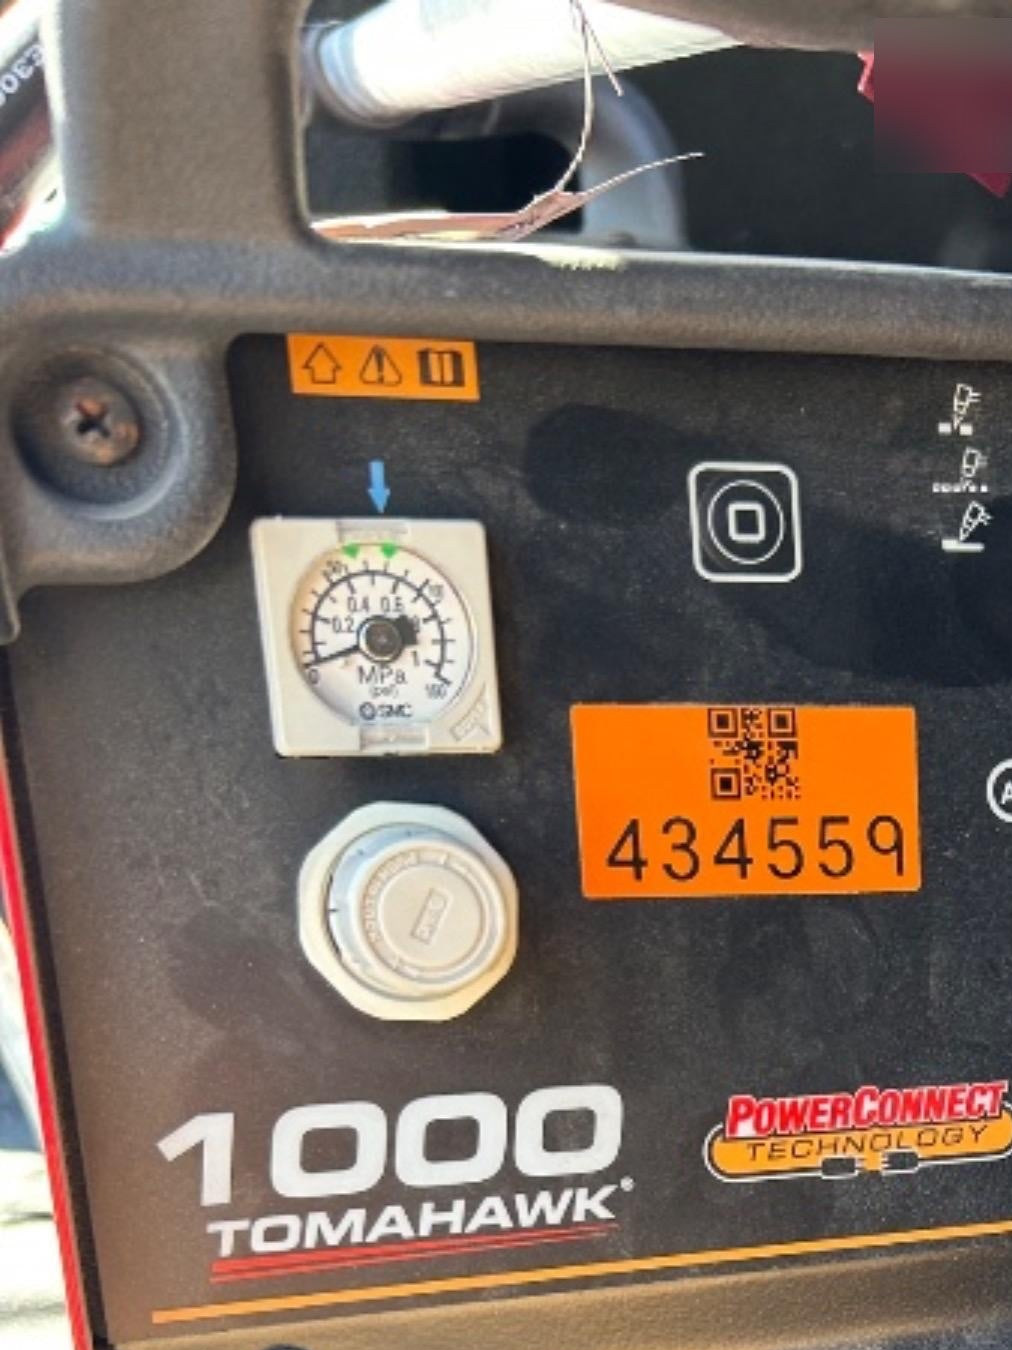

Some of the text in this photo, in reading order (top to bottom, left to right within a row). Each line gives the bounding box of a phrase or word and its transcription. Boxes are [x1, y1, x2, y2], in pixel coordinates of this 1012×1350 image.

[332, 615, 354, 633] 0.2
[358, 664, 408, 685] MPa
[607, 815, 904, 881] 434559
[155, 1084, 623, 1207] 1000
[747, 1123, 990, 1163] TECHNOLOGY
